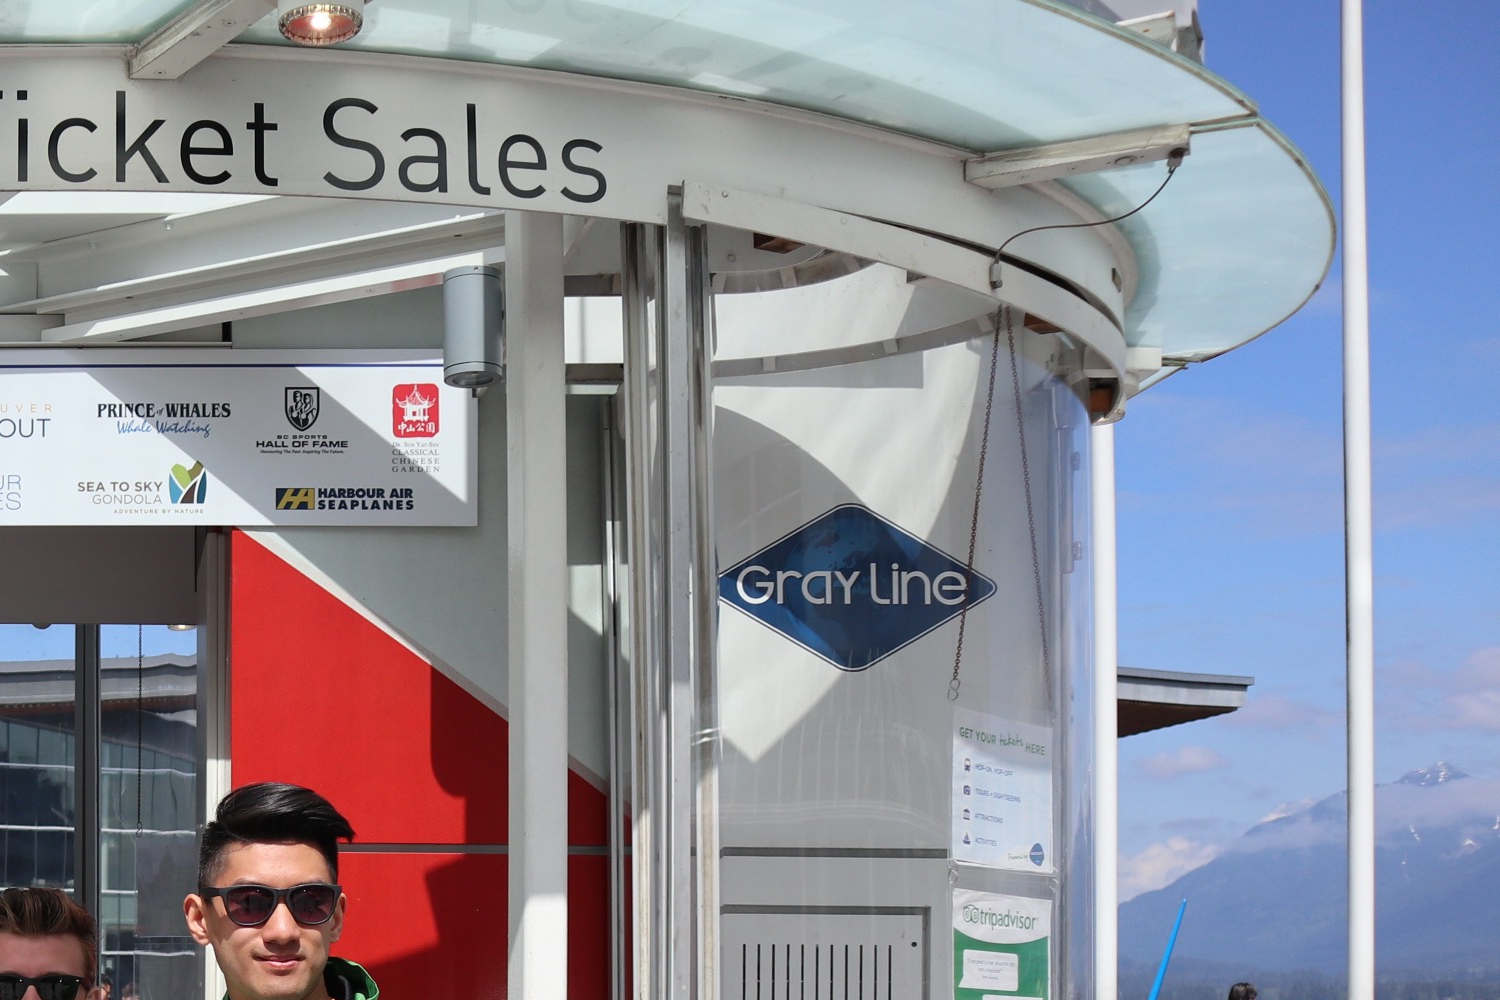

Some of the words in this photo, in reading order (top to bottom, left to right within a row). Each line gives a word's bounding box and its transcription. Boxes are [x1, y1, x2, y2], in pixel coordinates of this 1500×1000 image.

[321, 96, 609, 204] Sales
[97, 403, 155, 418] PRINCE
[165, 403, 232, 418] WHALES
[117, 420, 153, 435] Whale
[156, 421, 211, 438] Watching
[256, 441, 289, 449] HALL
[292, 441, 309, 449] OF
[312, 441, 349, 449] FAME
[392, 457, 440, 465] CHINESE
[77, 481, 106, 492] SEA
[110, 481, 130, 492] TO
[134, 481, 163, 492] SKY
[92, 494, 163, 505] GONDOLA
[318, 488, 385, 499] HARBOUR
[387, 488, 414, 499] AIR
[318, 499, 415, 510] SEAPLANES
[736, 564, 861, 606] Gray
[869, 562, 969, 606] Line
[959, 726, 974, 740] GET
[976, 730, 997, 745] YOUR
[999, 732, 1024, 747] tickets
[1025, 743, 1046, 756] HERE
[975, 787, 989, 797] TOURS
[993, 790, 1022, 804] SIGHTSEEING
[974, 812, 1003, 824] ATTRACTIONS
[974, 837, 998, 847] ACTIVITIES
[980, 907, 1037, 931] tripadvisor
